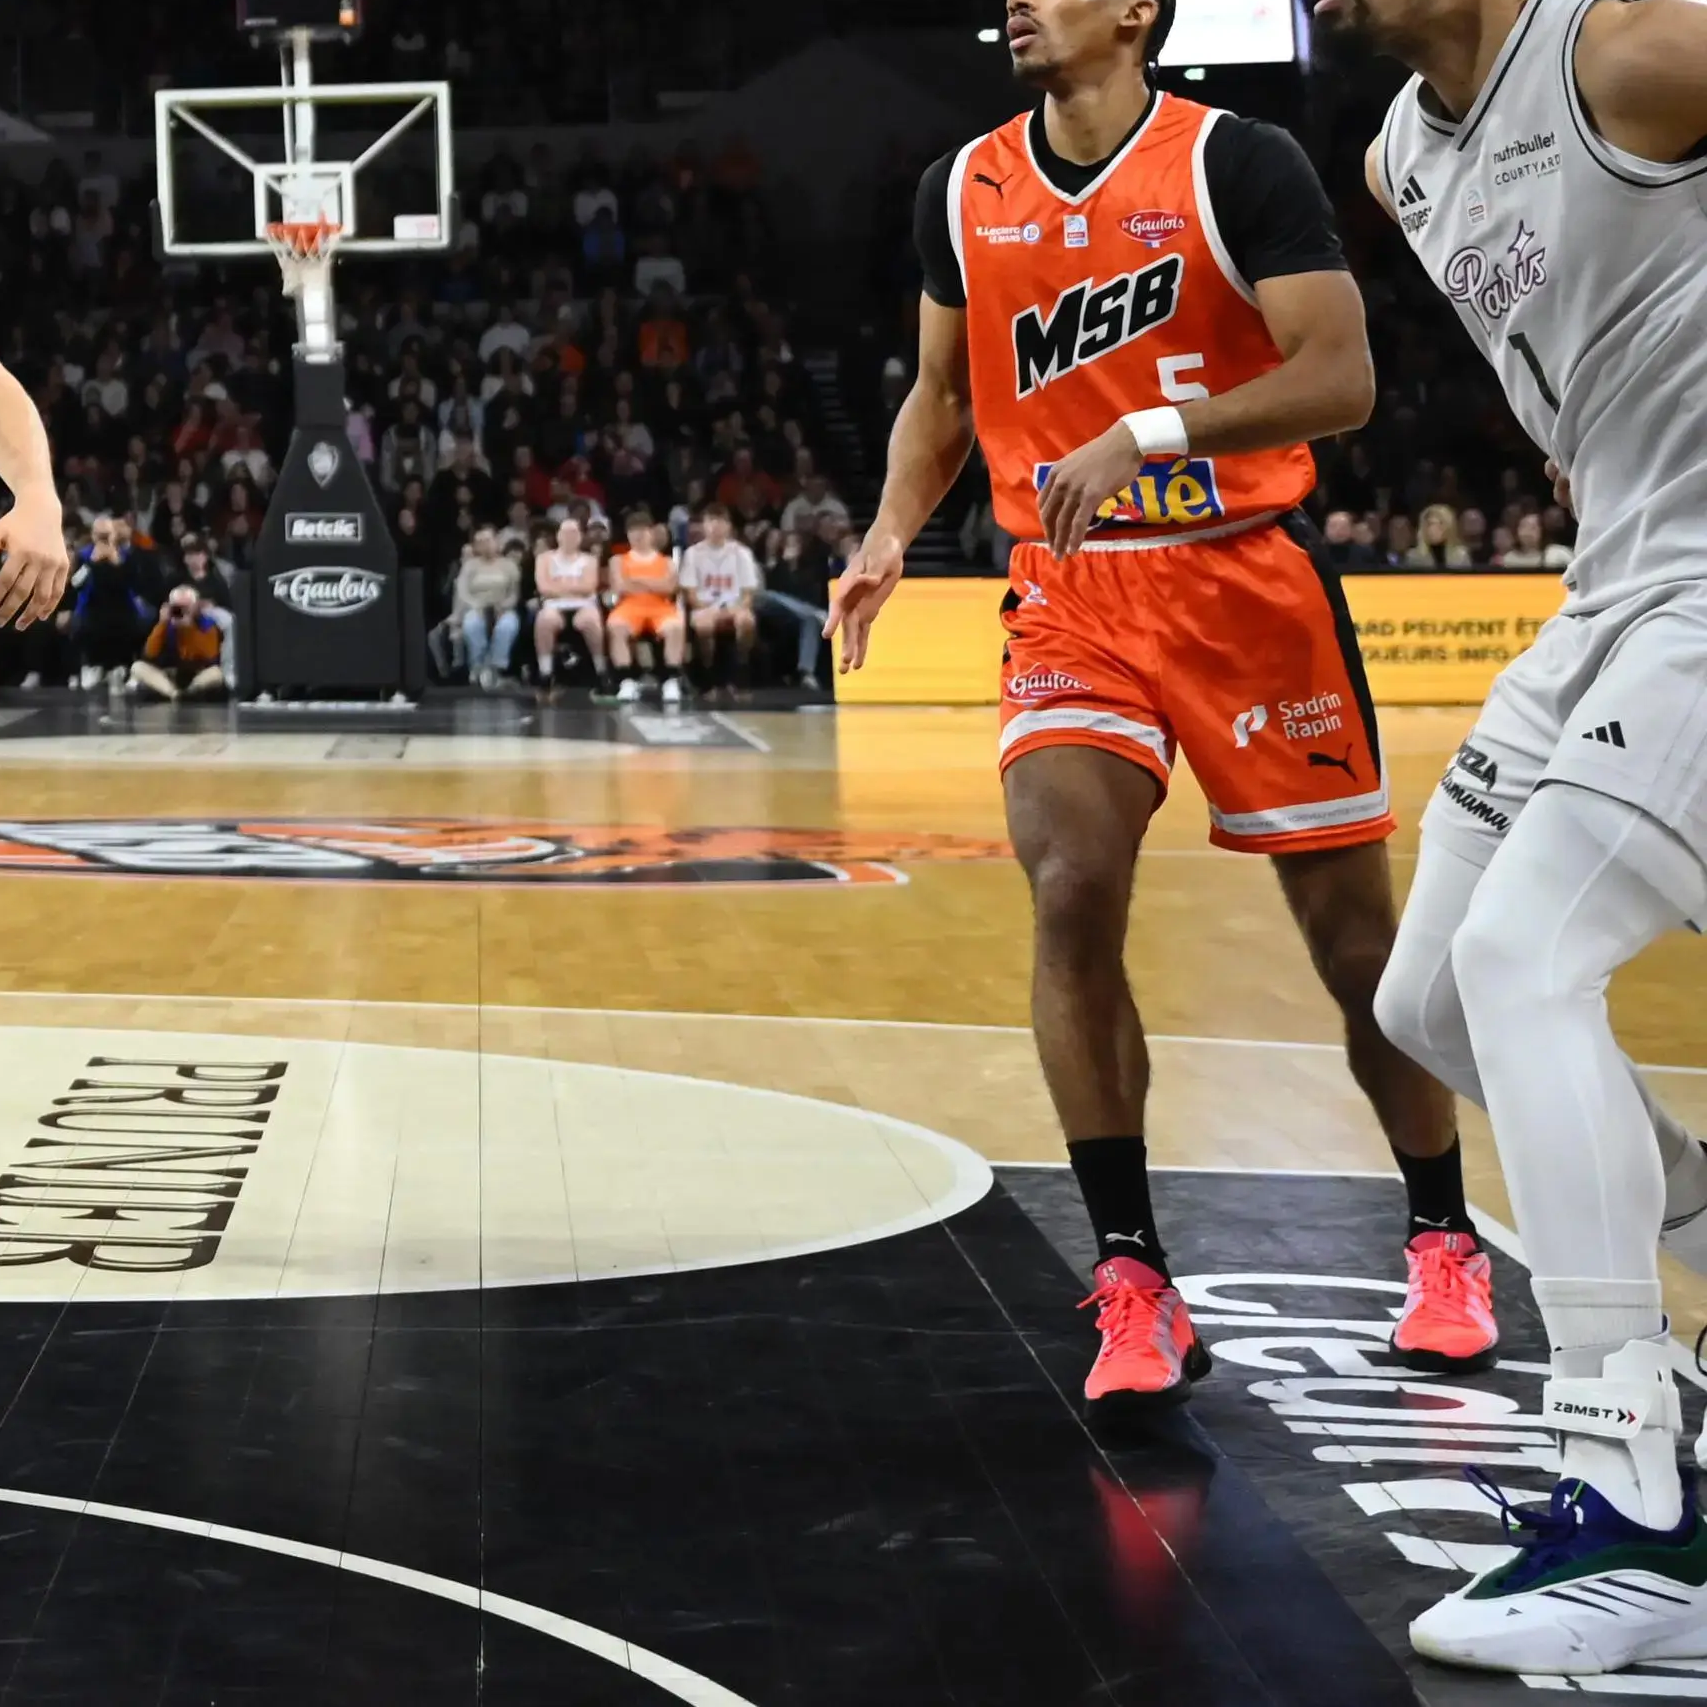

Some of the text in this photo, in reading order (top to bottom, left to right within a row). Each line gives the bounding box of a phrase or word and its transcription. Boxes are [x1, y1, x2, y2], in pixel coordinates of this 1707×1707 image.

[1493, 132, 1556, 164] nutribullet
[1494, 154, 1562, 186] COURTYARD
[1130, 216, 1185, 235] Gaulois
[1445, 245, 1546, 339] Paris
[1011, 253, 1184, 401] MSB
[1156, 353, 1209, 402] 5
[291, 518, 357, 537] Betclic
[289, 572, 381, 608] Gaulois
[1402, 618, 1507, 637] PEUVENT
[1515, 614, 1548, 636] ÊT
[1278, 692, 1342, 719] Sadrin
[1283, 714, 1342, 740] Rapin
